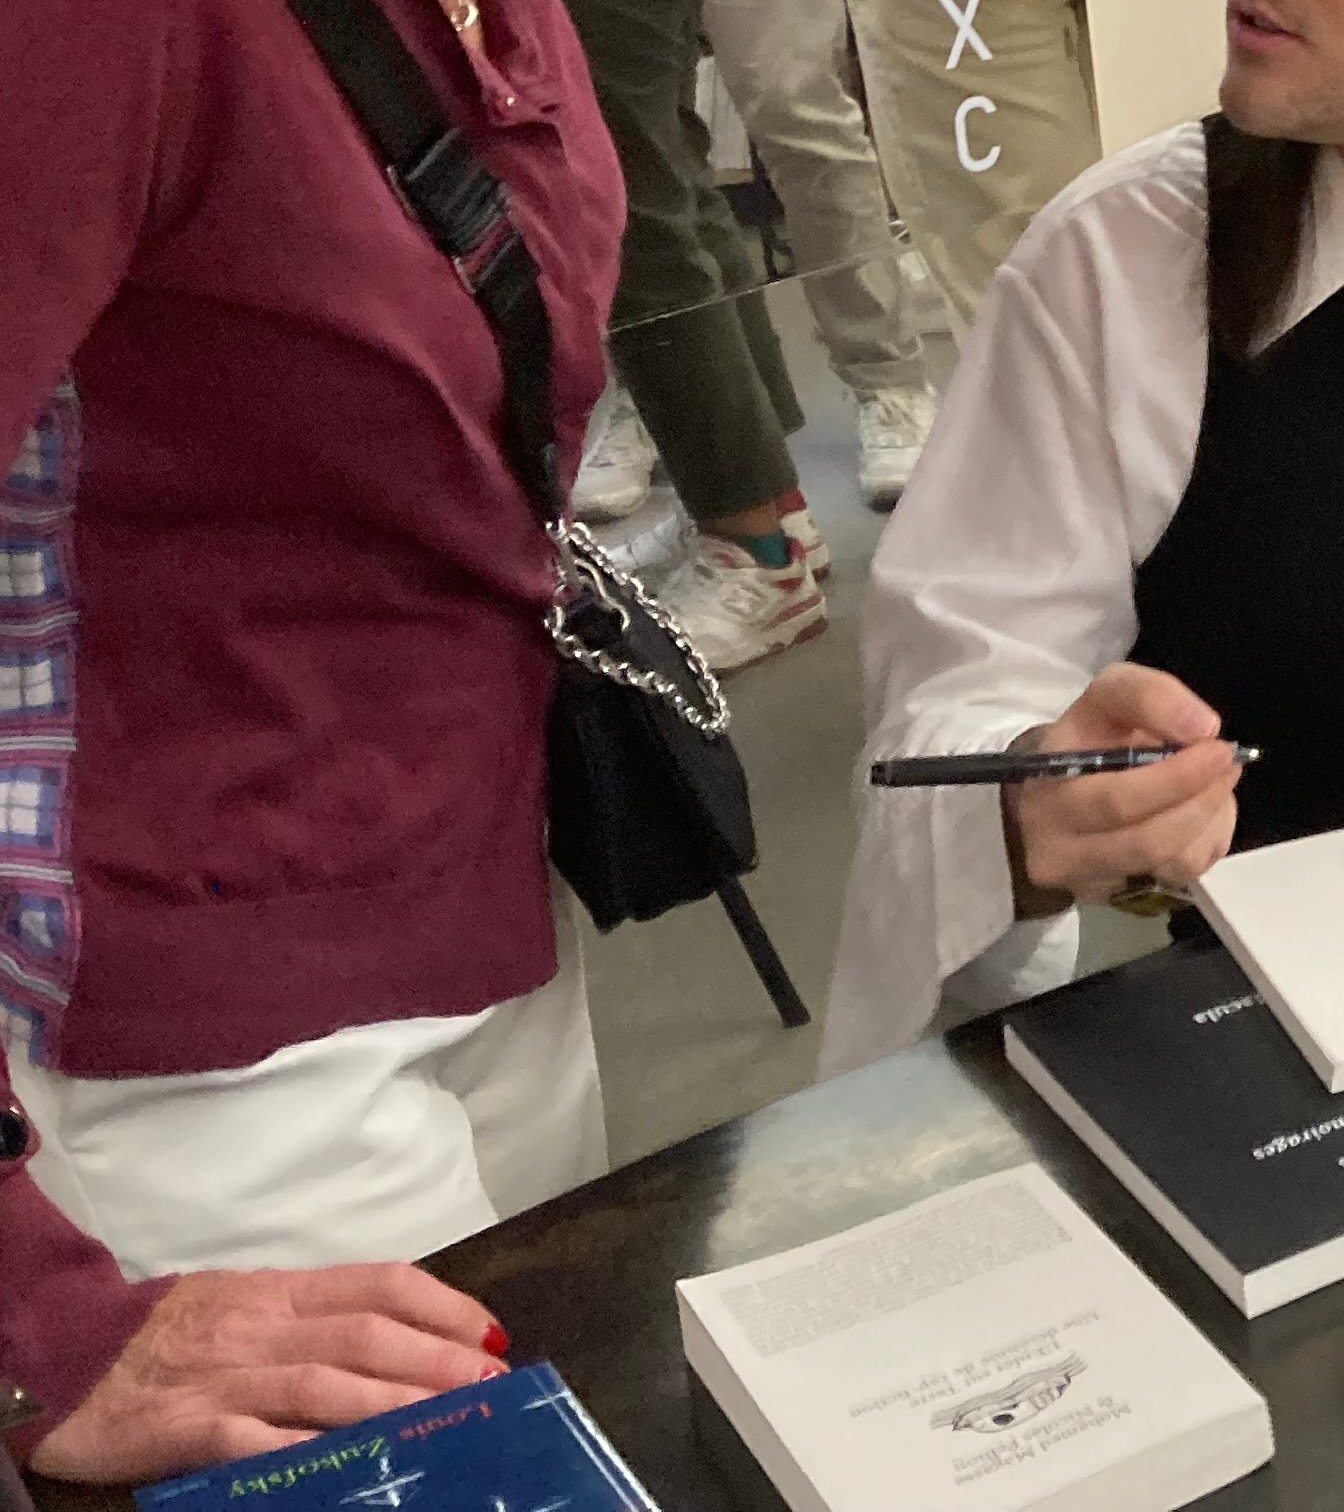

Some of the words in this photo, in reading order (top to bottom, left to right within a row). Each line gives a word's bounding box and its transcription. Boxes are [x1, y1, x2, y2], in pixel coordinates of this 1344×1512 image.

[1193, 991, 1266, 1025] acula
[399, 1402, 492, 1440] Louis
[230, 1436, 387, 1497] Zukofsky
